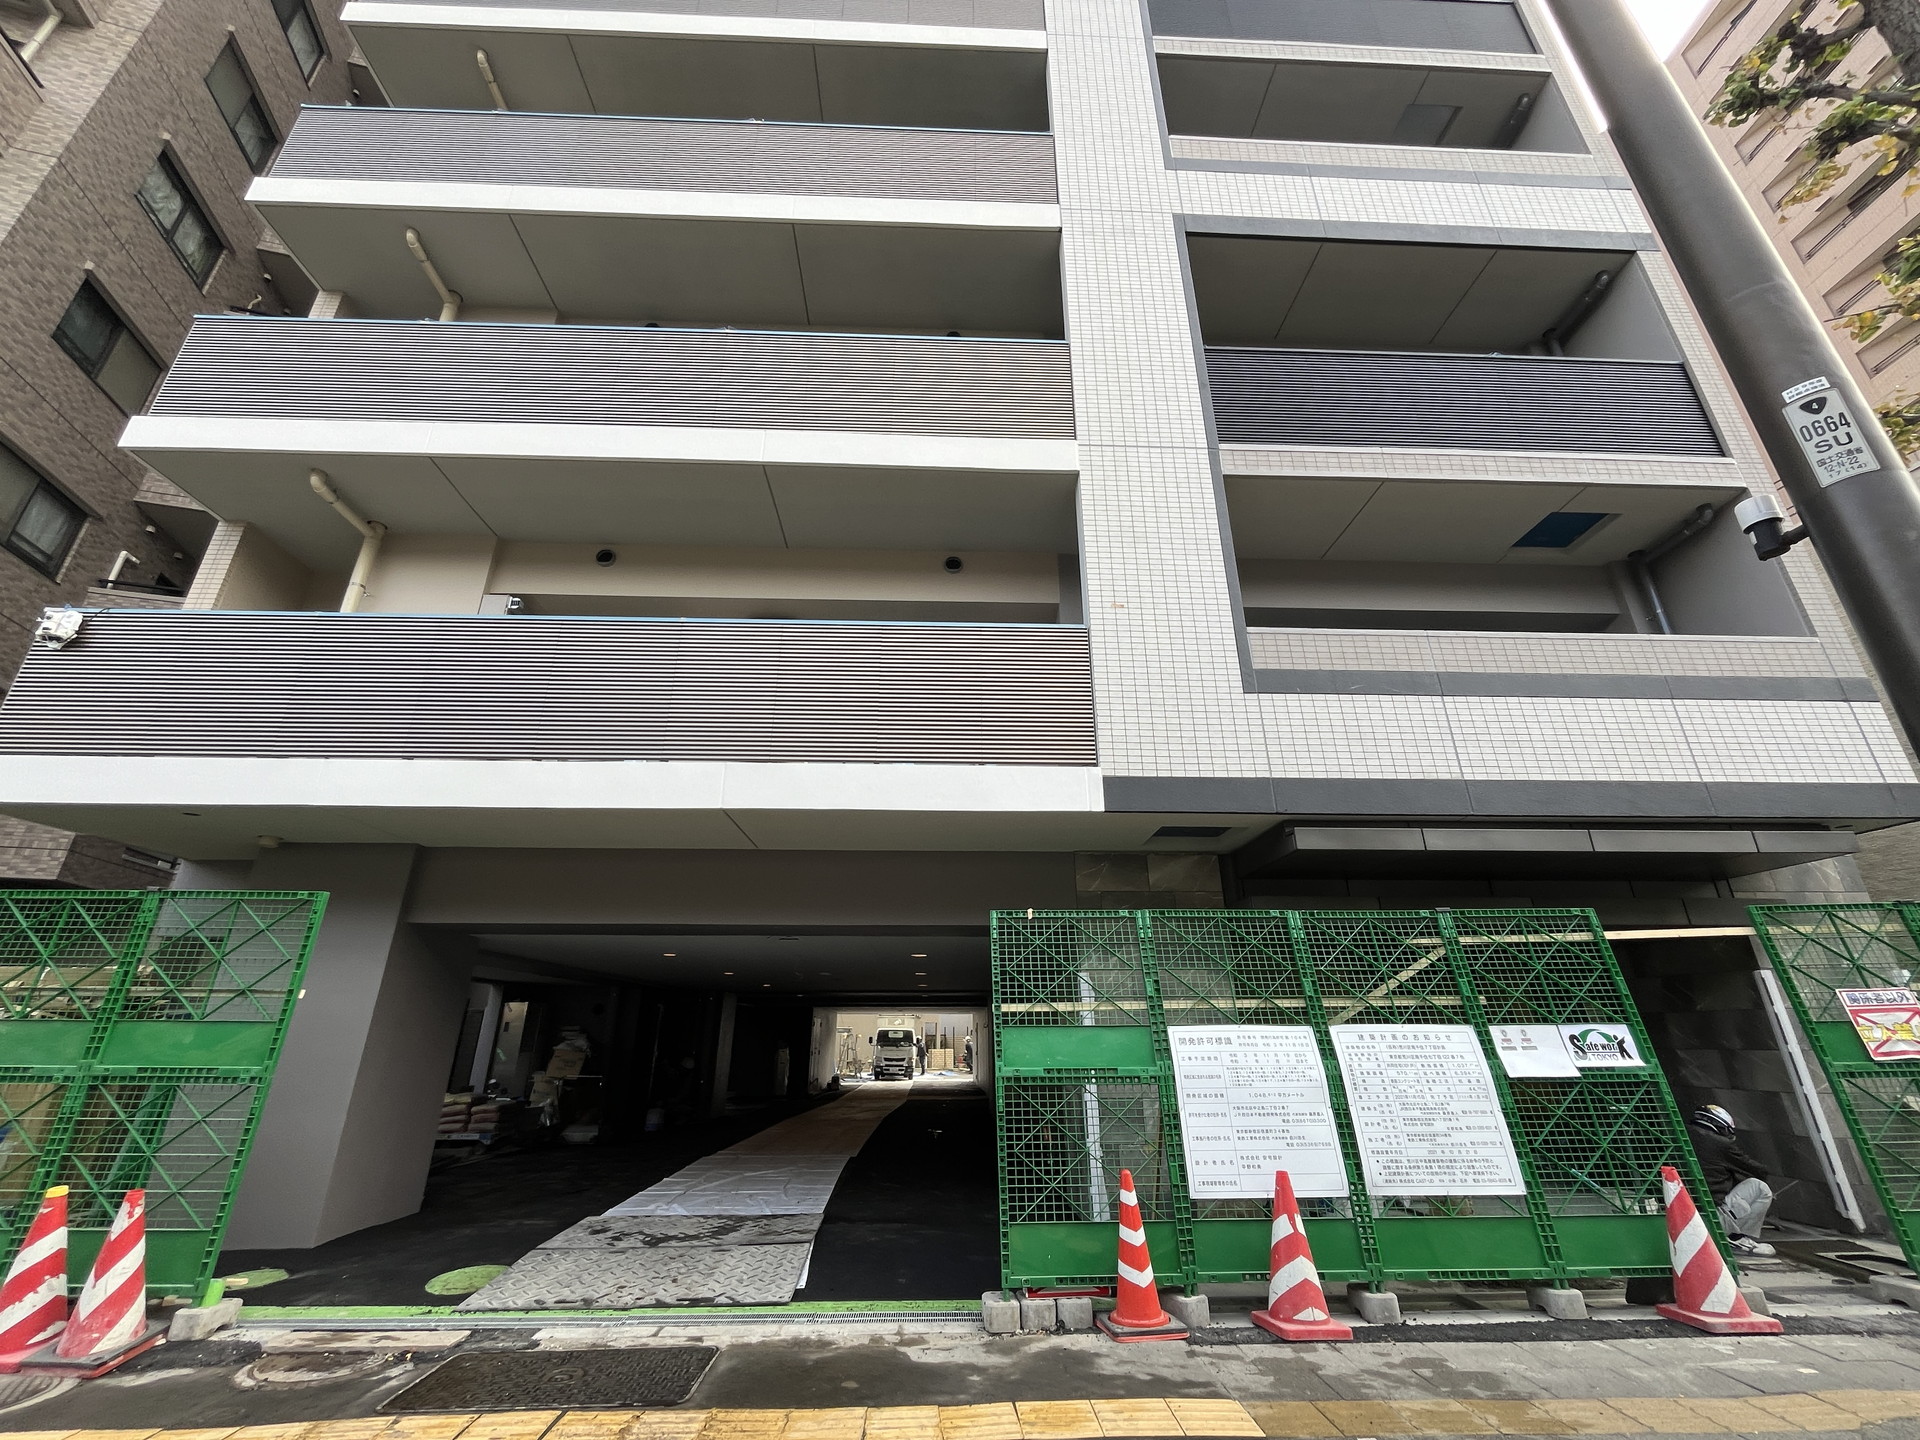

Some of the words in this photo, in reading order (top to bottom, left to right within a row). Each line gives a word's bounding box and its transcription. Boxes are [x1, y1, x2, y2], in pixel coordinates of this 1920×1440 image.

[1800, 412, 1851, 442] 0664
[1815, 432, 1853, 454] SU
[1817, 447, 1863, 467] 国土交通省
[1824, 456, 1859, 473] 12-N-22
[1846, 992, 1910, 1004] 関係者以外
[1179, 1037, 1232, 1046] 開発許可標識
[1857, 1022, 1920, 1042] 立入禁
